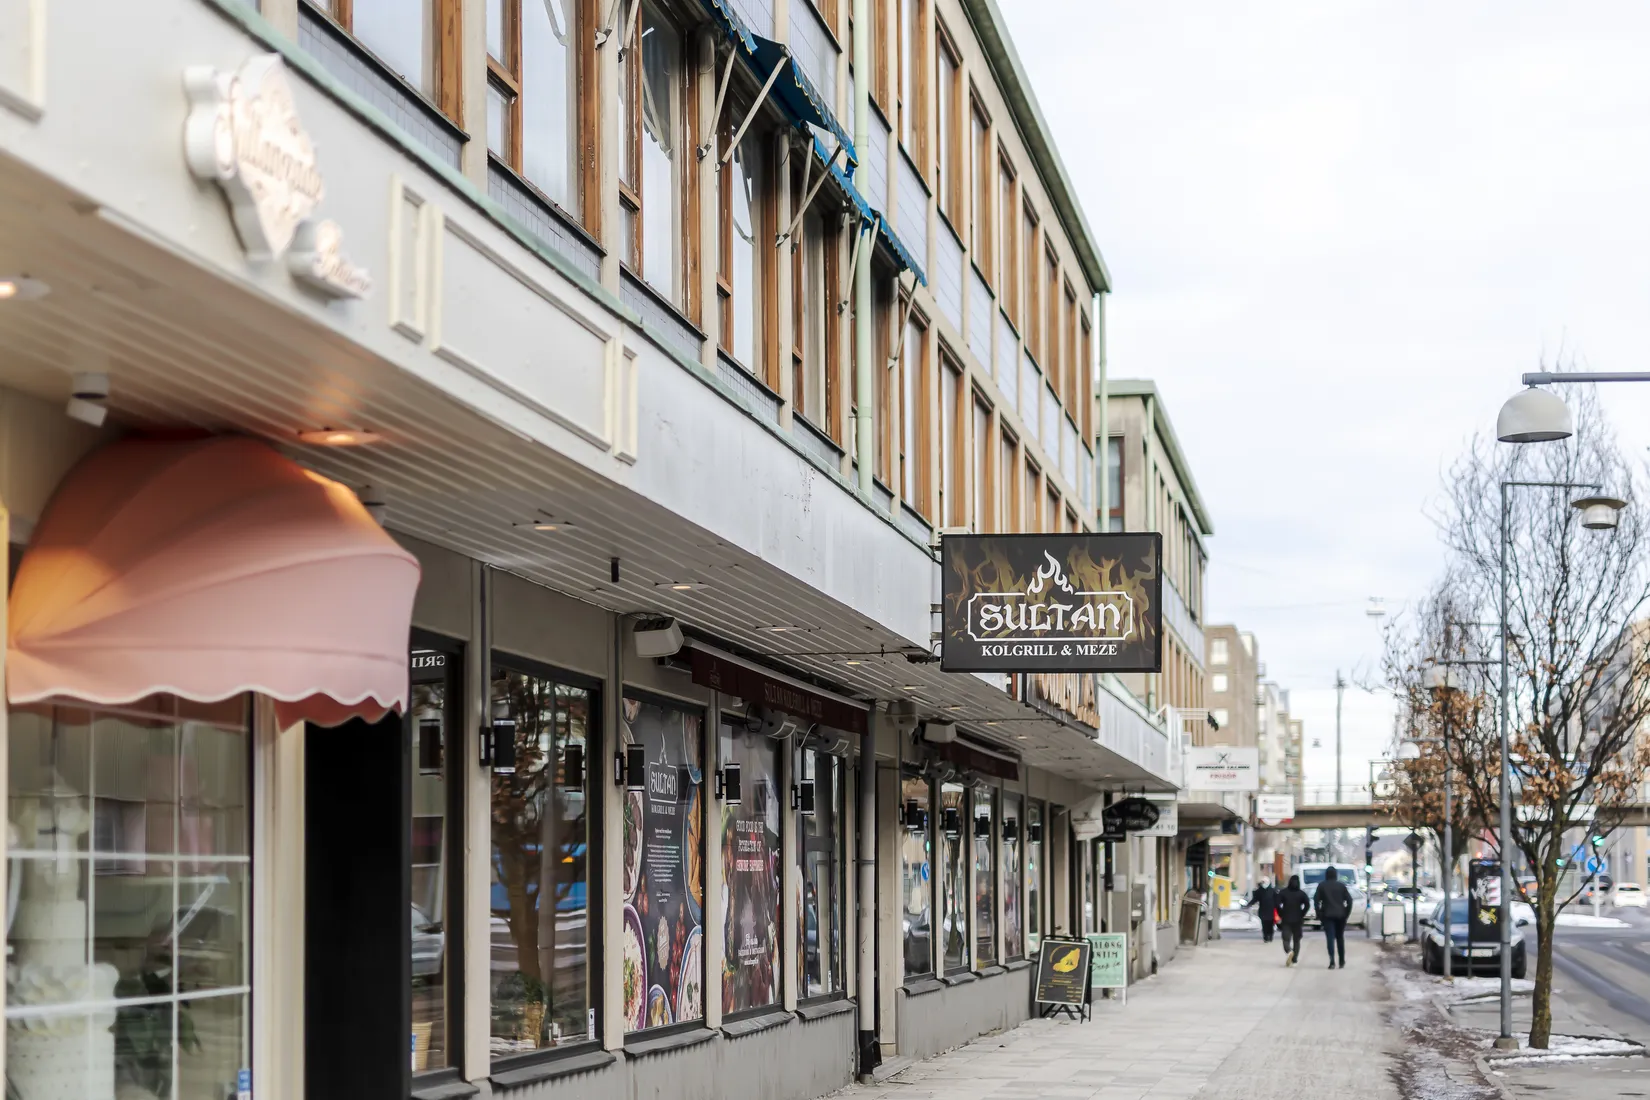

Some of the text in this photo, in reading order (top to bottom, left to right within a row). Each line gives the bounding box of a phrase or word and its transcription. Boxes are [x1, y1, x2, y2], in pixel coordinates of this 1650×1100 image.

[980, 602, 1121, 631] SULTAN
[982, 644, 1118, 657] KOLGRILL & MEZE
[650, 771, 677, 796] SULTAN
